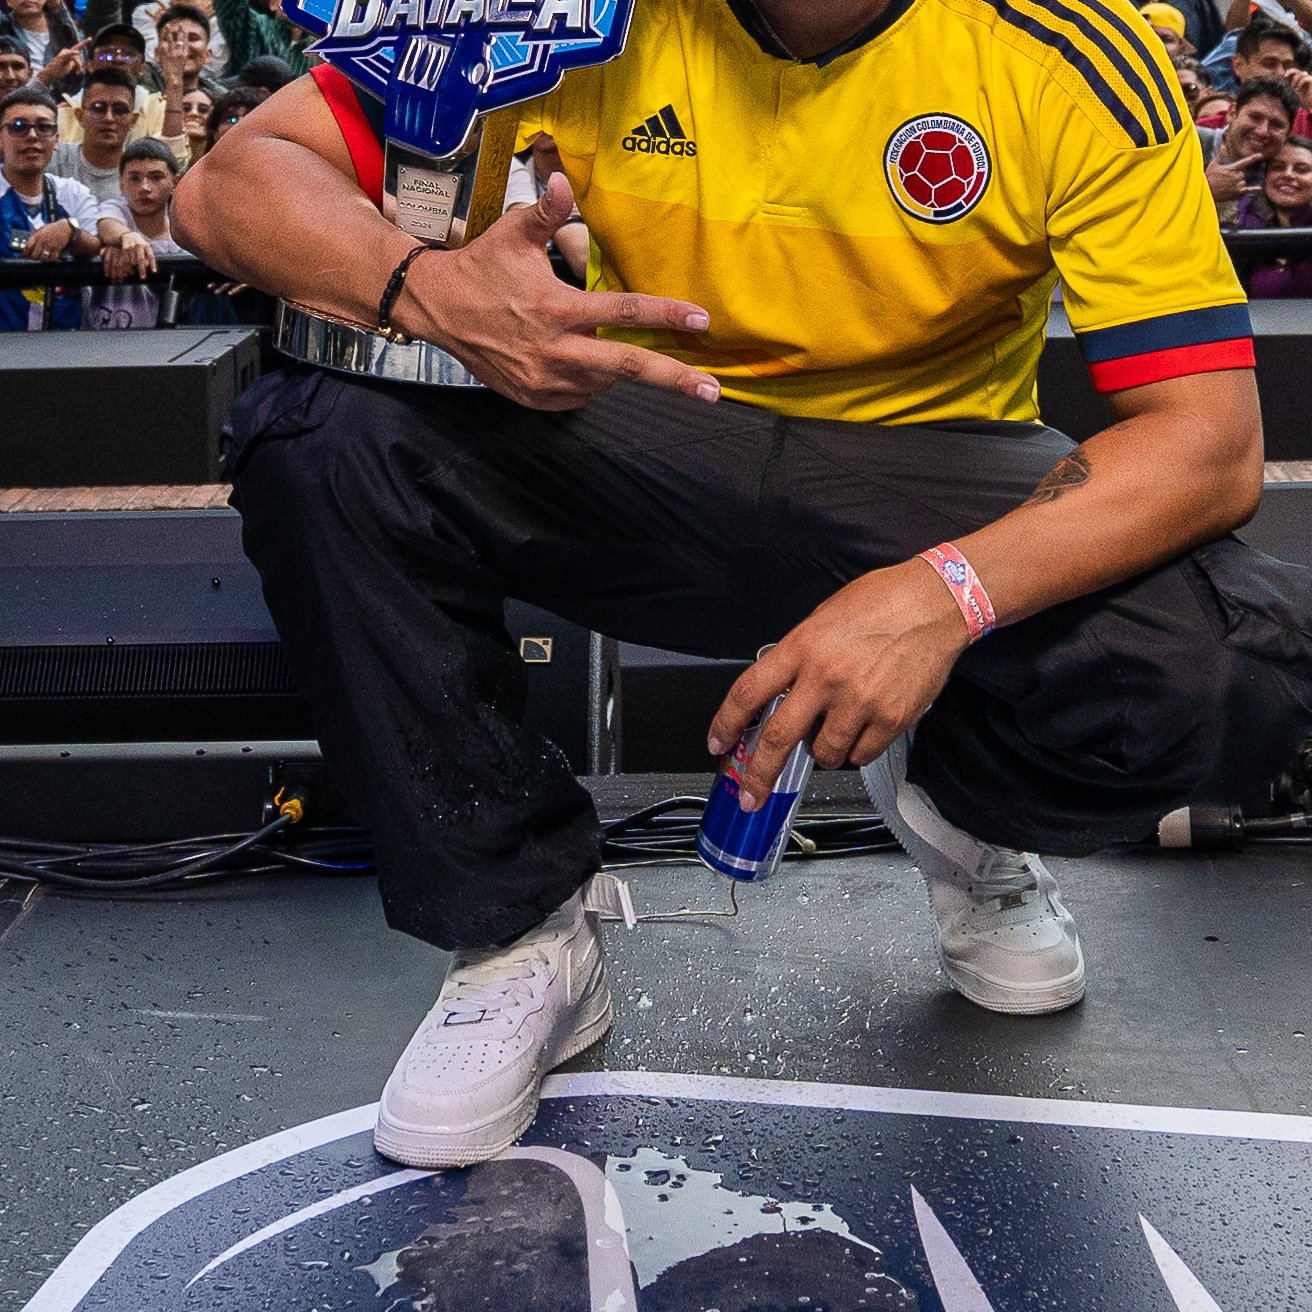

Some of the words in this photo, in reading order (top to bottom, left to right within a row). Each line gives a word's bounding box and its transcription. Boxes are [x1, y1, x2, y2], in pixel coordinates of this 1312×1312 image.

[622, 136, 697, 157] adidas
[890, 125, 918, 165] FEDERACION
[915, 119, 966, 136] COLOMBIANA
[964, 131, 976, 145] DE
[970, 142, 986, 171] FUTBOL
[402, 183, 451, 198] NACIONAL
[413, 178, 441, 191] FINAL
